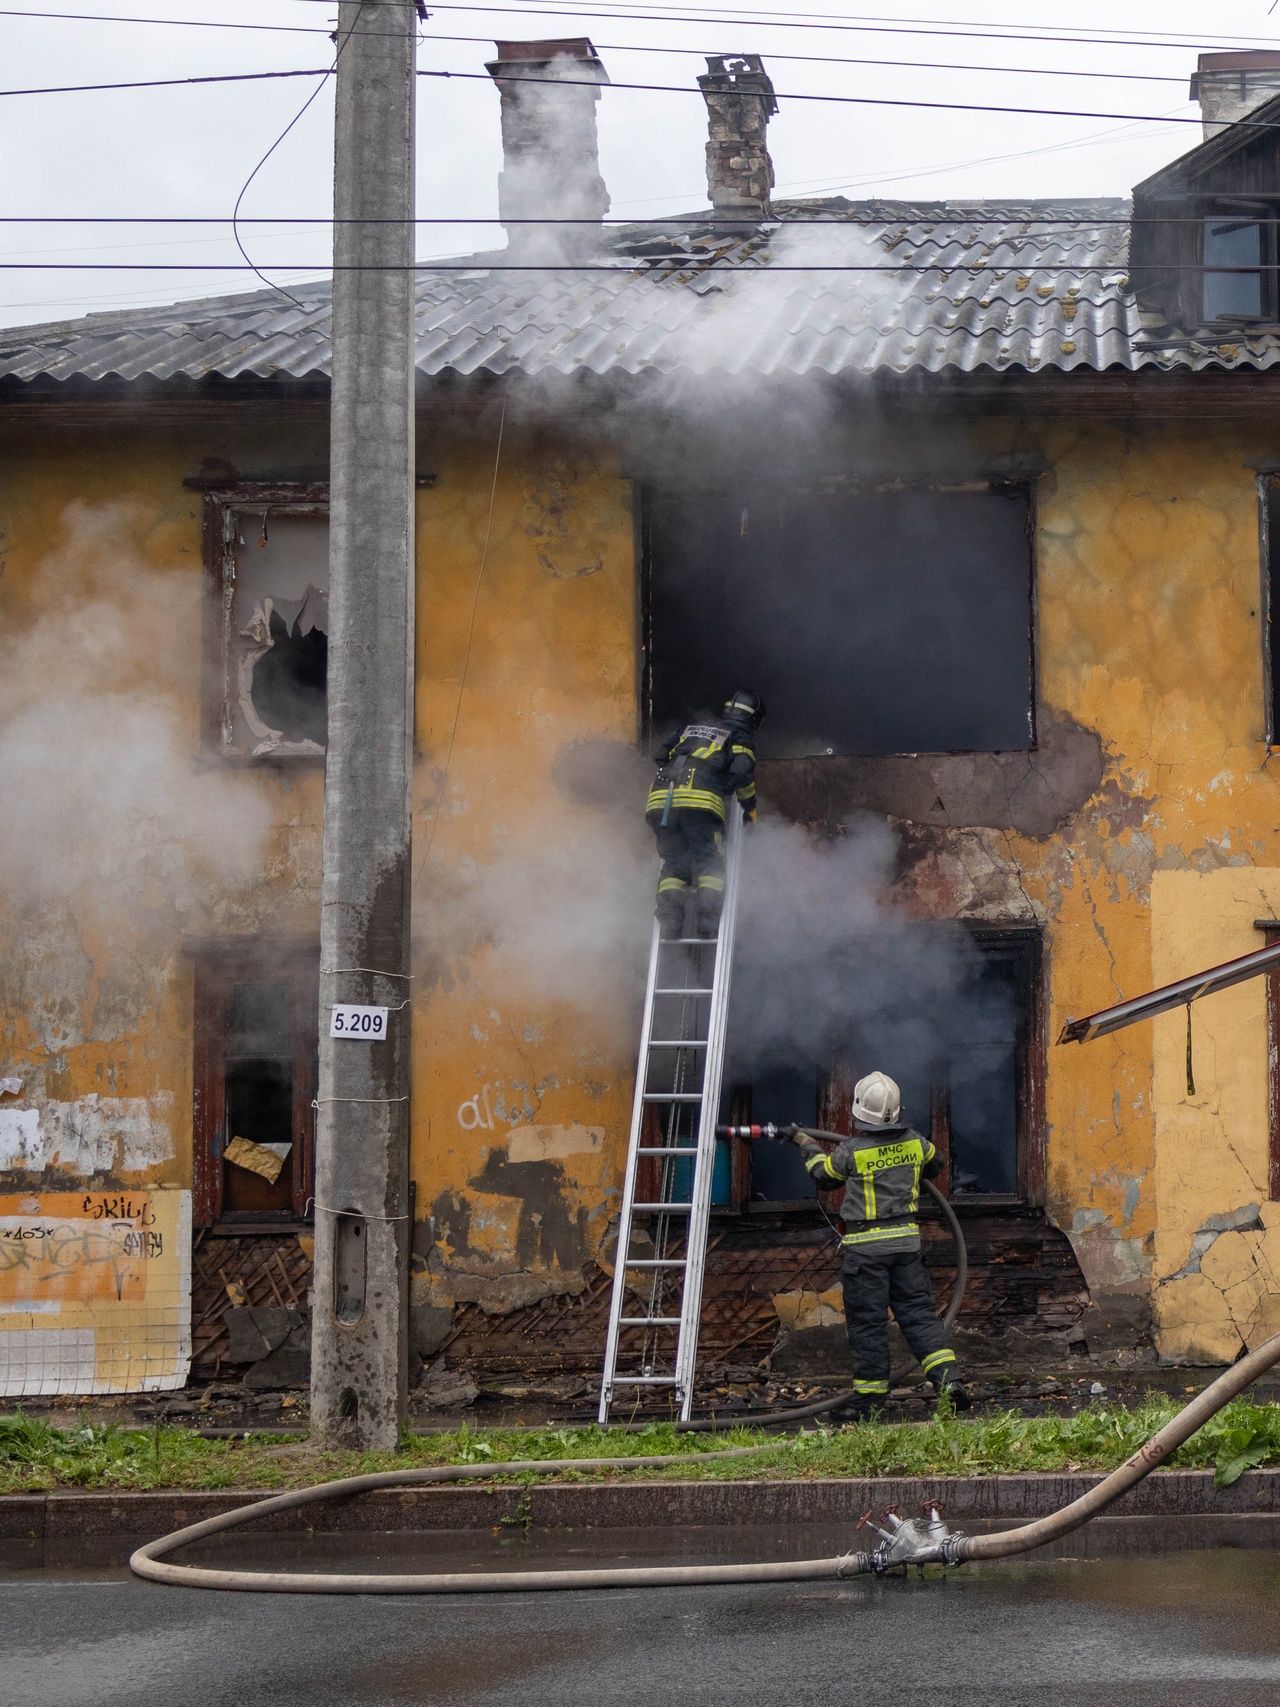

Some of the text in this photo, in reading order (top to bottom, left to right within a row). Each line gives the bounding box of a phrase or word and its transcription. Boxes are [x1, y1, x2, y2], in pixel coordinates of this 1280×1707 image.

[334, 1013, 383, 1033] 5.209
[878, 1144, 903, 1157] МЧС
[866, 1152, 917, 1171] РОССИИ
